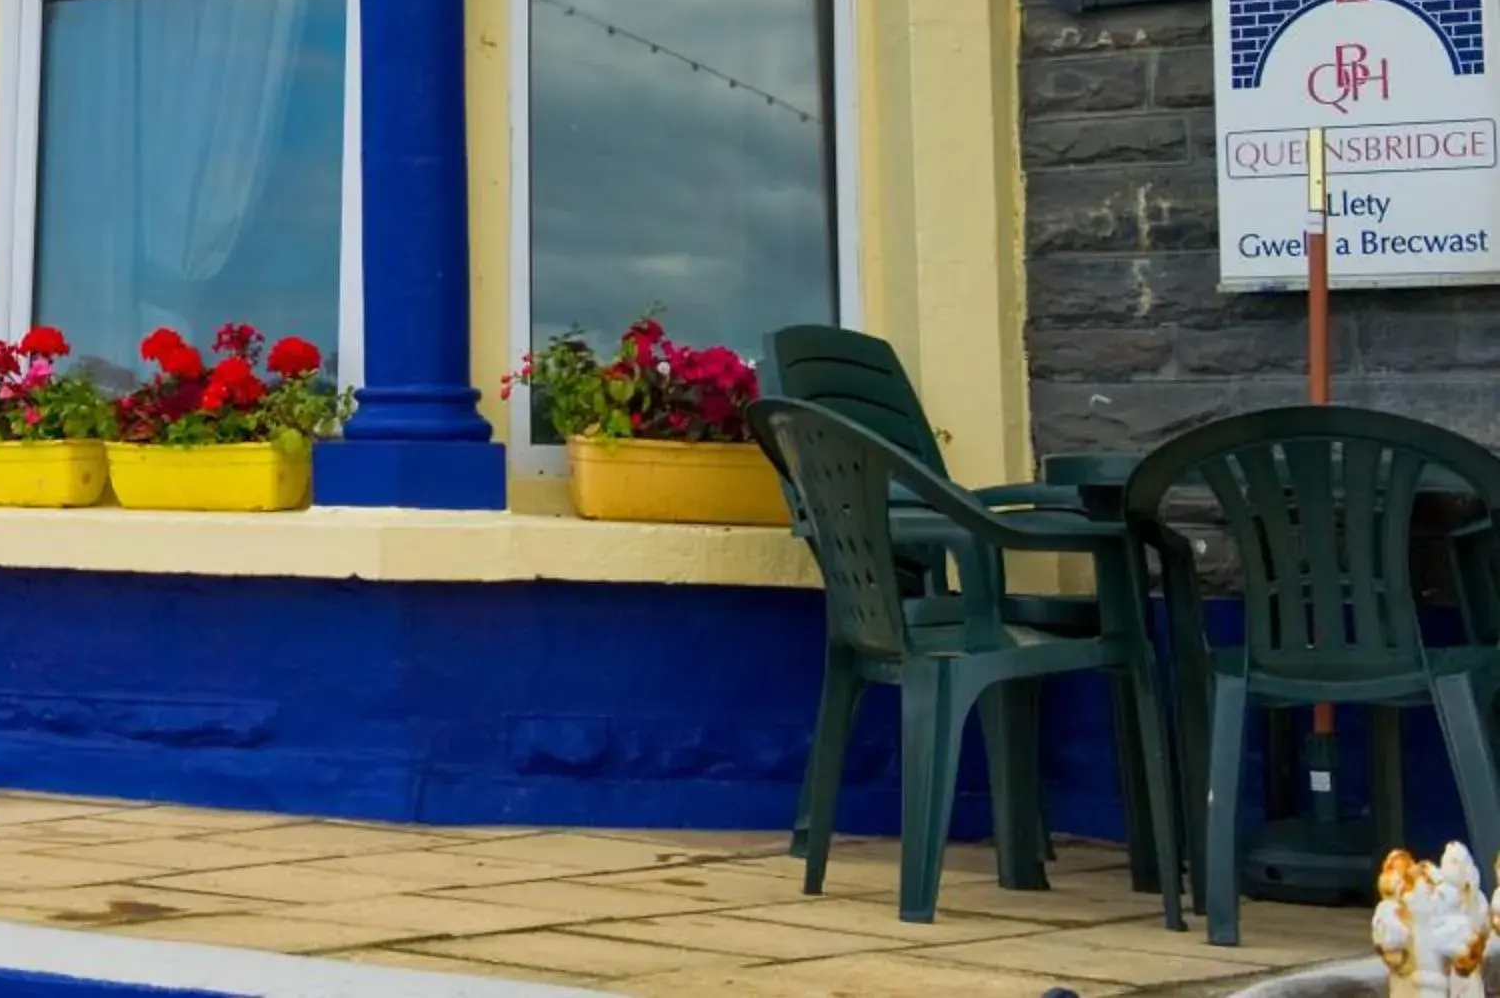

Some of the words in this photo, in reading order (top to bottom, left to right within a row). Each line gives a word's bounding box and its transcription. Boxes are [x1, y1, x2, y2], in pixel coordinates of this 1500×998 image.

[1235, 131, 1487, 173] QUENSBRIDGE
[1326, 189, 1391, 224] Llety
[1238, 230, 1309, 259] Gwel
[1335, 236, 1352, 256] a
[1360, 229, 1489, 255] Brecwast
